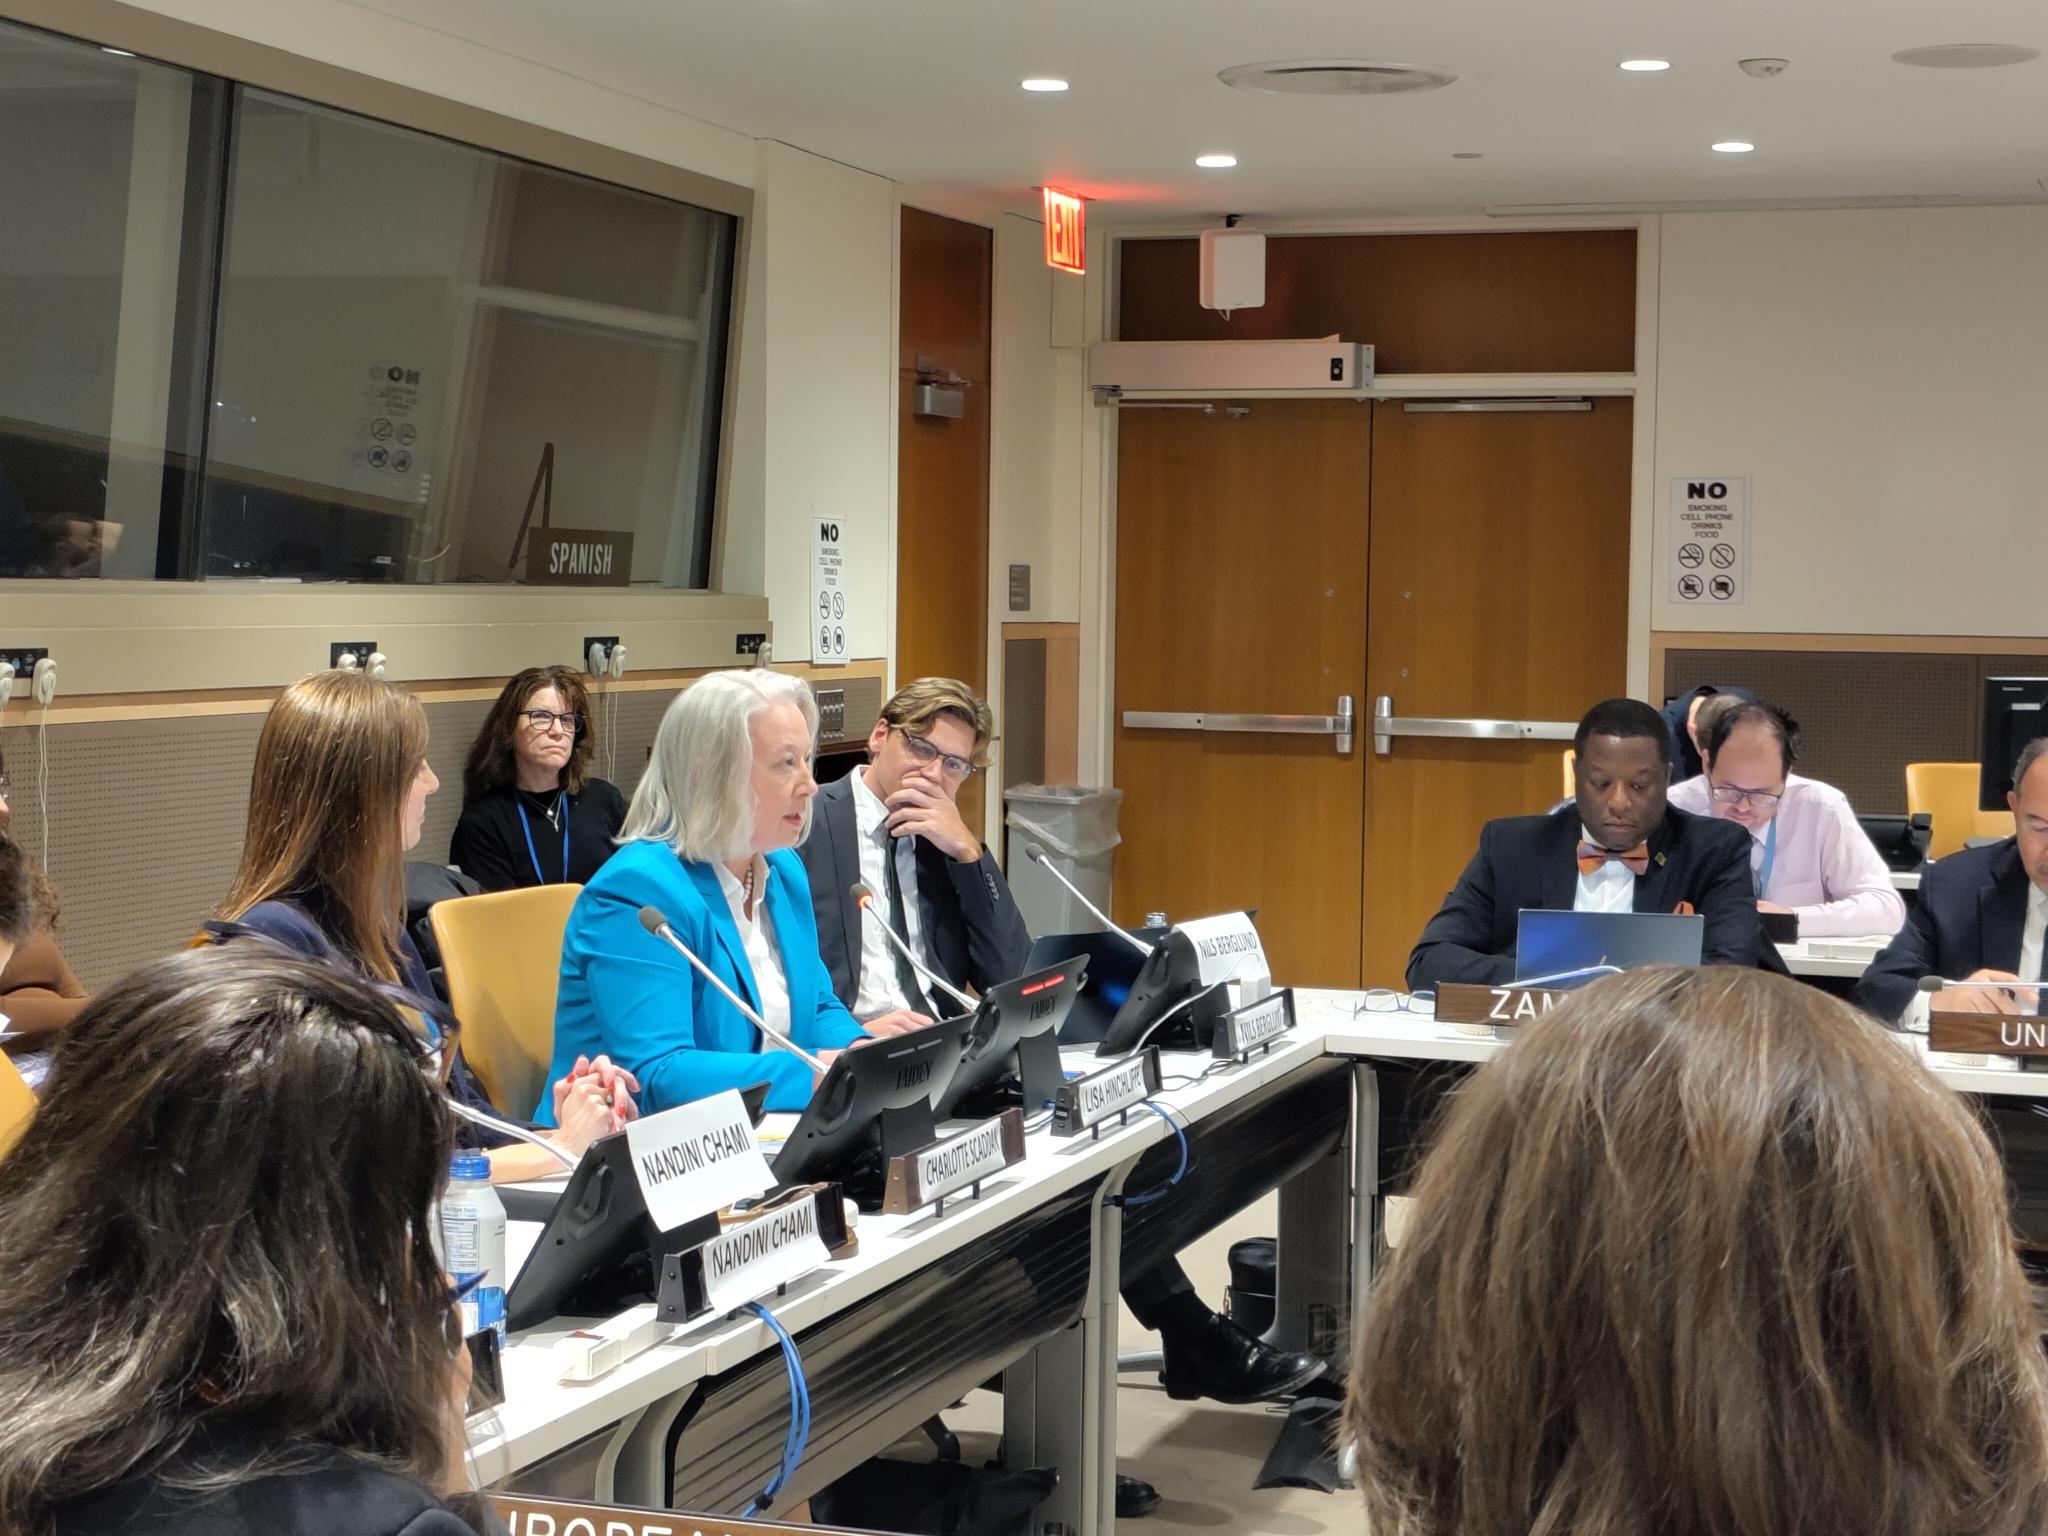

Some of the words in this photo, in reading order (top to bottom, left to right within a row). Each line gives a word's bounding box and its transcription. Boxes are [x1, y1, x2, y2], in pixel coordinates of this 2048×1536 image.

[1050, 191, 1080, 267] EXIT
[1687, 482, 1727, 500] NO
[1680, 513, 1701, 521] CELL
[1705, 513, 1734, 521] PHONE
[1688, 504, 1727, 512] SMOKING
[821, 523, 839, 542] NO
[1691, 522, 1722, 530] DRINKS
[550, 542, 613, 575] SPANISH
[1197, 938, 1218, 959] NILS
[1216, 931, 1257, 955] BERGLUND
[2001, 1021, 2046, 1048] UN
[1085, 1083, 1105, 1112] LISA
[641, 1138, 704, 1187] NANDINI
[702, 1122, 751, 1163] CHAMI
[926, 1142, 970, 1186] CHARLOTTE
[712, 1224, 768, 1278] NANDINI
[772, 1203, 812, 1248] CHAMI
